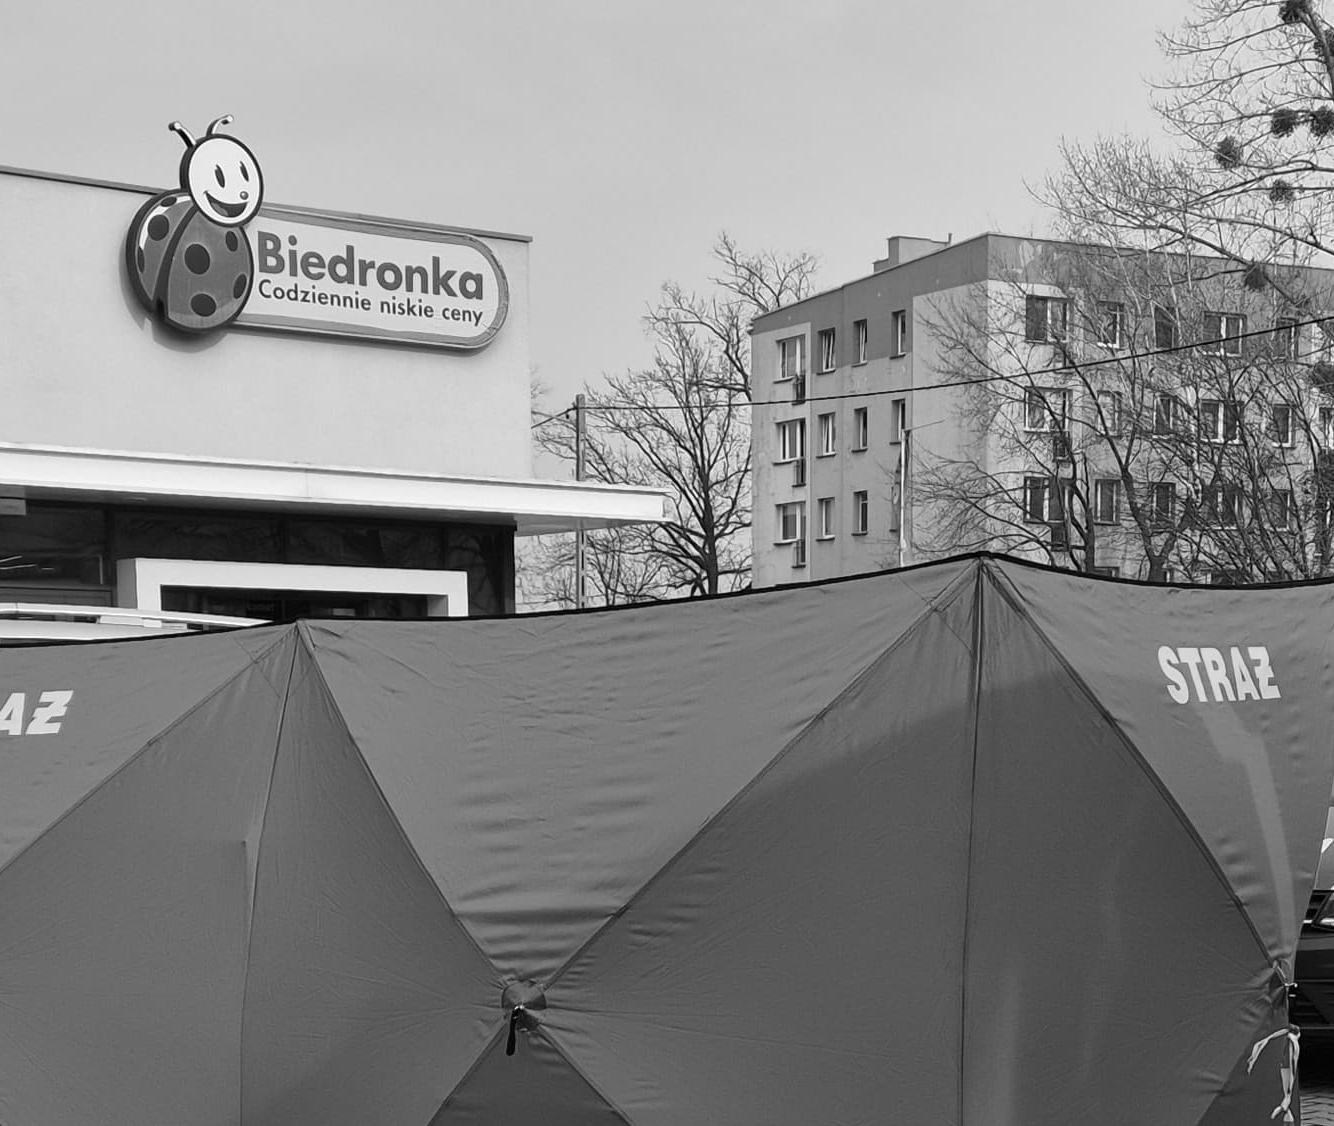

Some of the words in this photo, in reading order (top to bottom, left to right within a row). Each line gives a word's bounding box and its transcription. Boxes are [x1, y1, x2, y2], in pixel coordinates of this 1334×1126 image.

[258, 230, 483, 300] Biedronka
[258, 279, 372, 311] Codziennie
[380, 296, 434, 319] niskie
[442, 306, 483, 327] ceny
